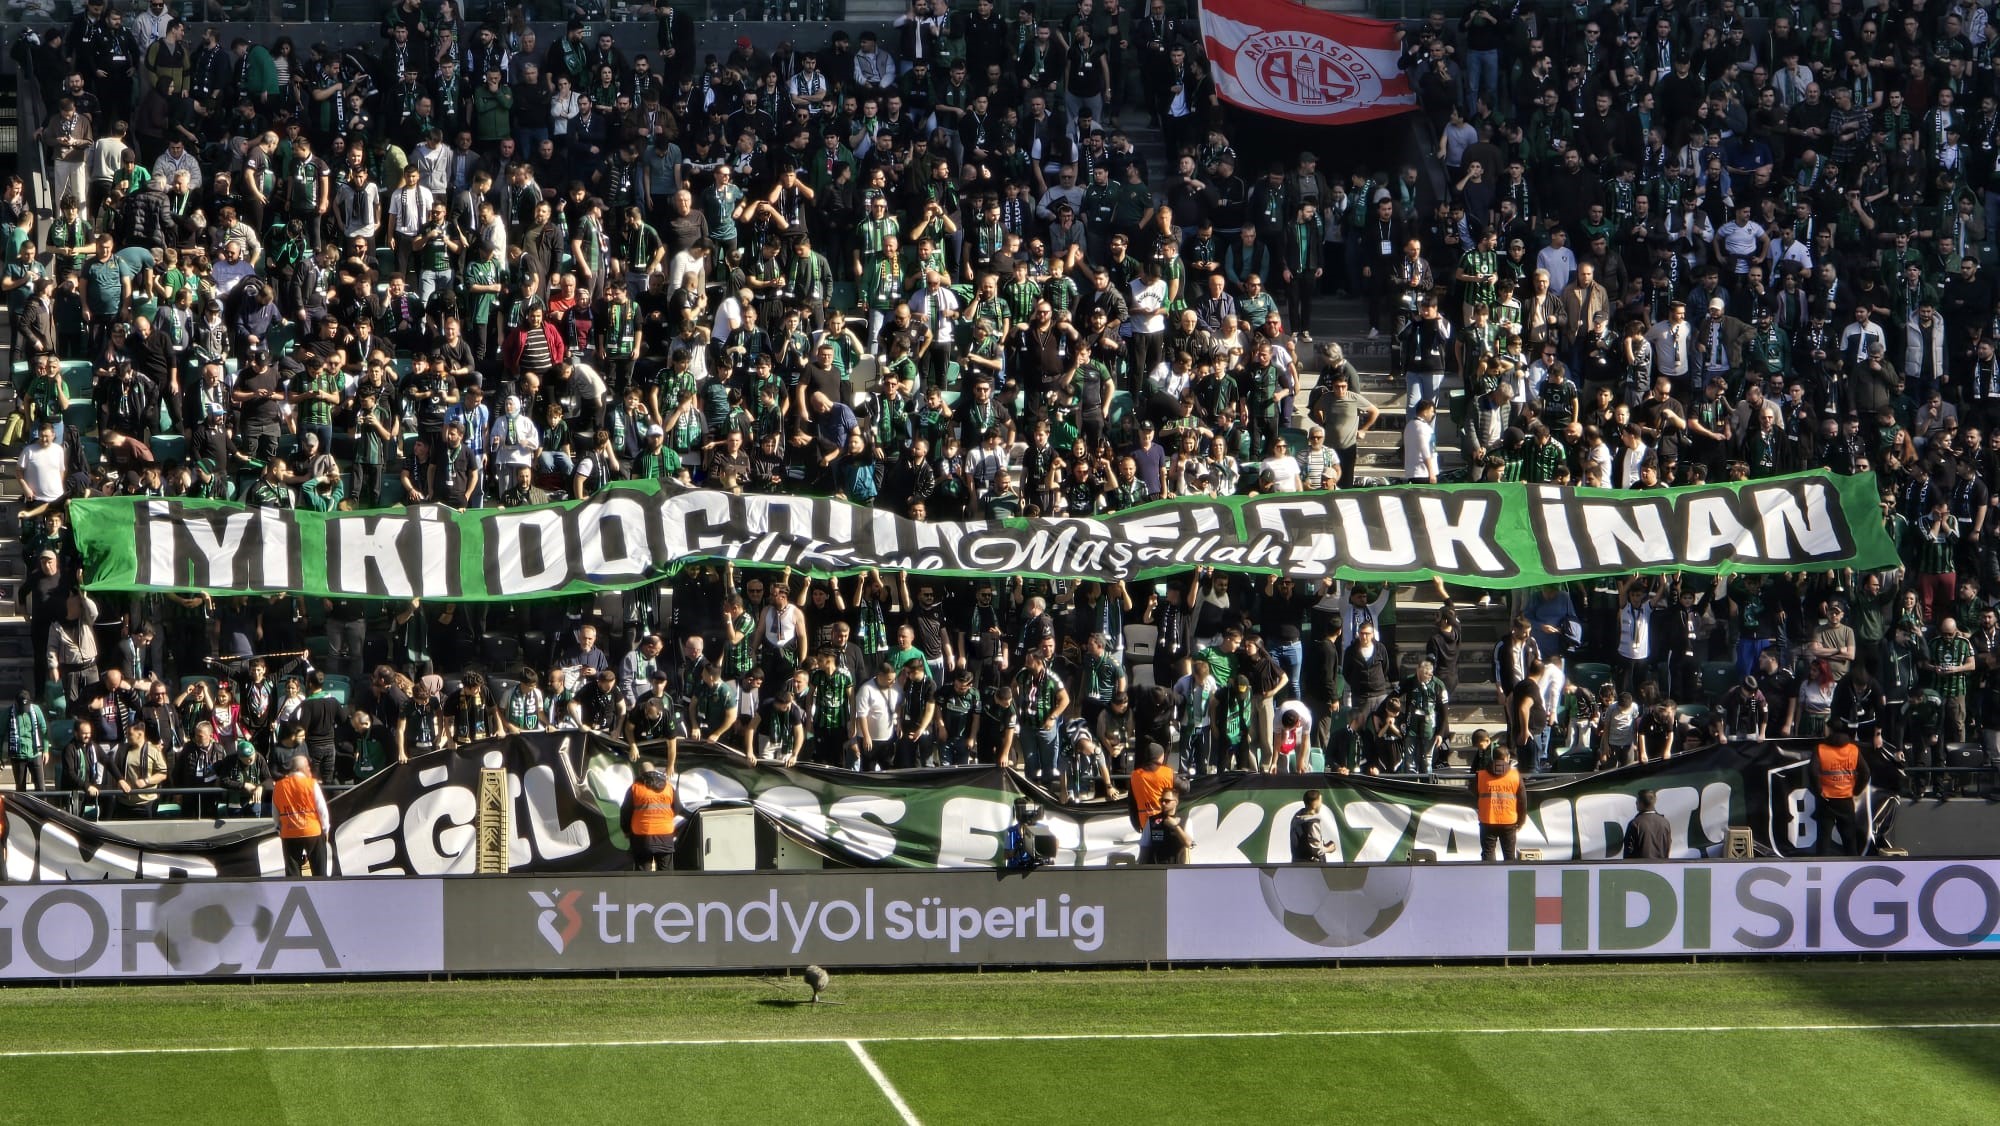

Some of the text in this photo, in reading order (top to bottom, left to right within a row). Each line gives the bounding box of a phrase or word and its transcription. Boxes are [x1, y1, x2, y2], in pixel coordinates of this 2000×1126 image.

[1244, 34, 1372, 82] ANTALYASPOR
[338, 505, 447, 599] Kİ
[1539, 484, 1842, 572] İNAN
[970, 527, 1283, 578] Maşallah
[258, 750, 592, 876] EĞİL
[592, 887, 1105, 954] trendyol SüperLig
[1507, 867, 1711, 951] HDI
